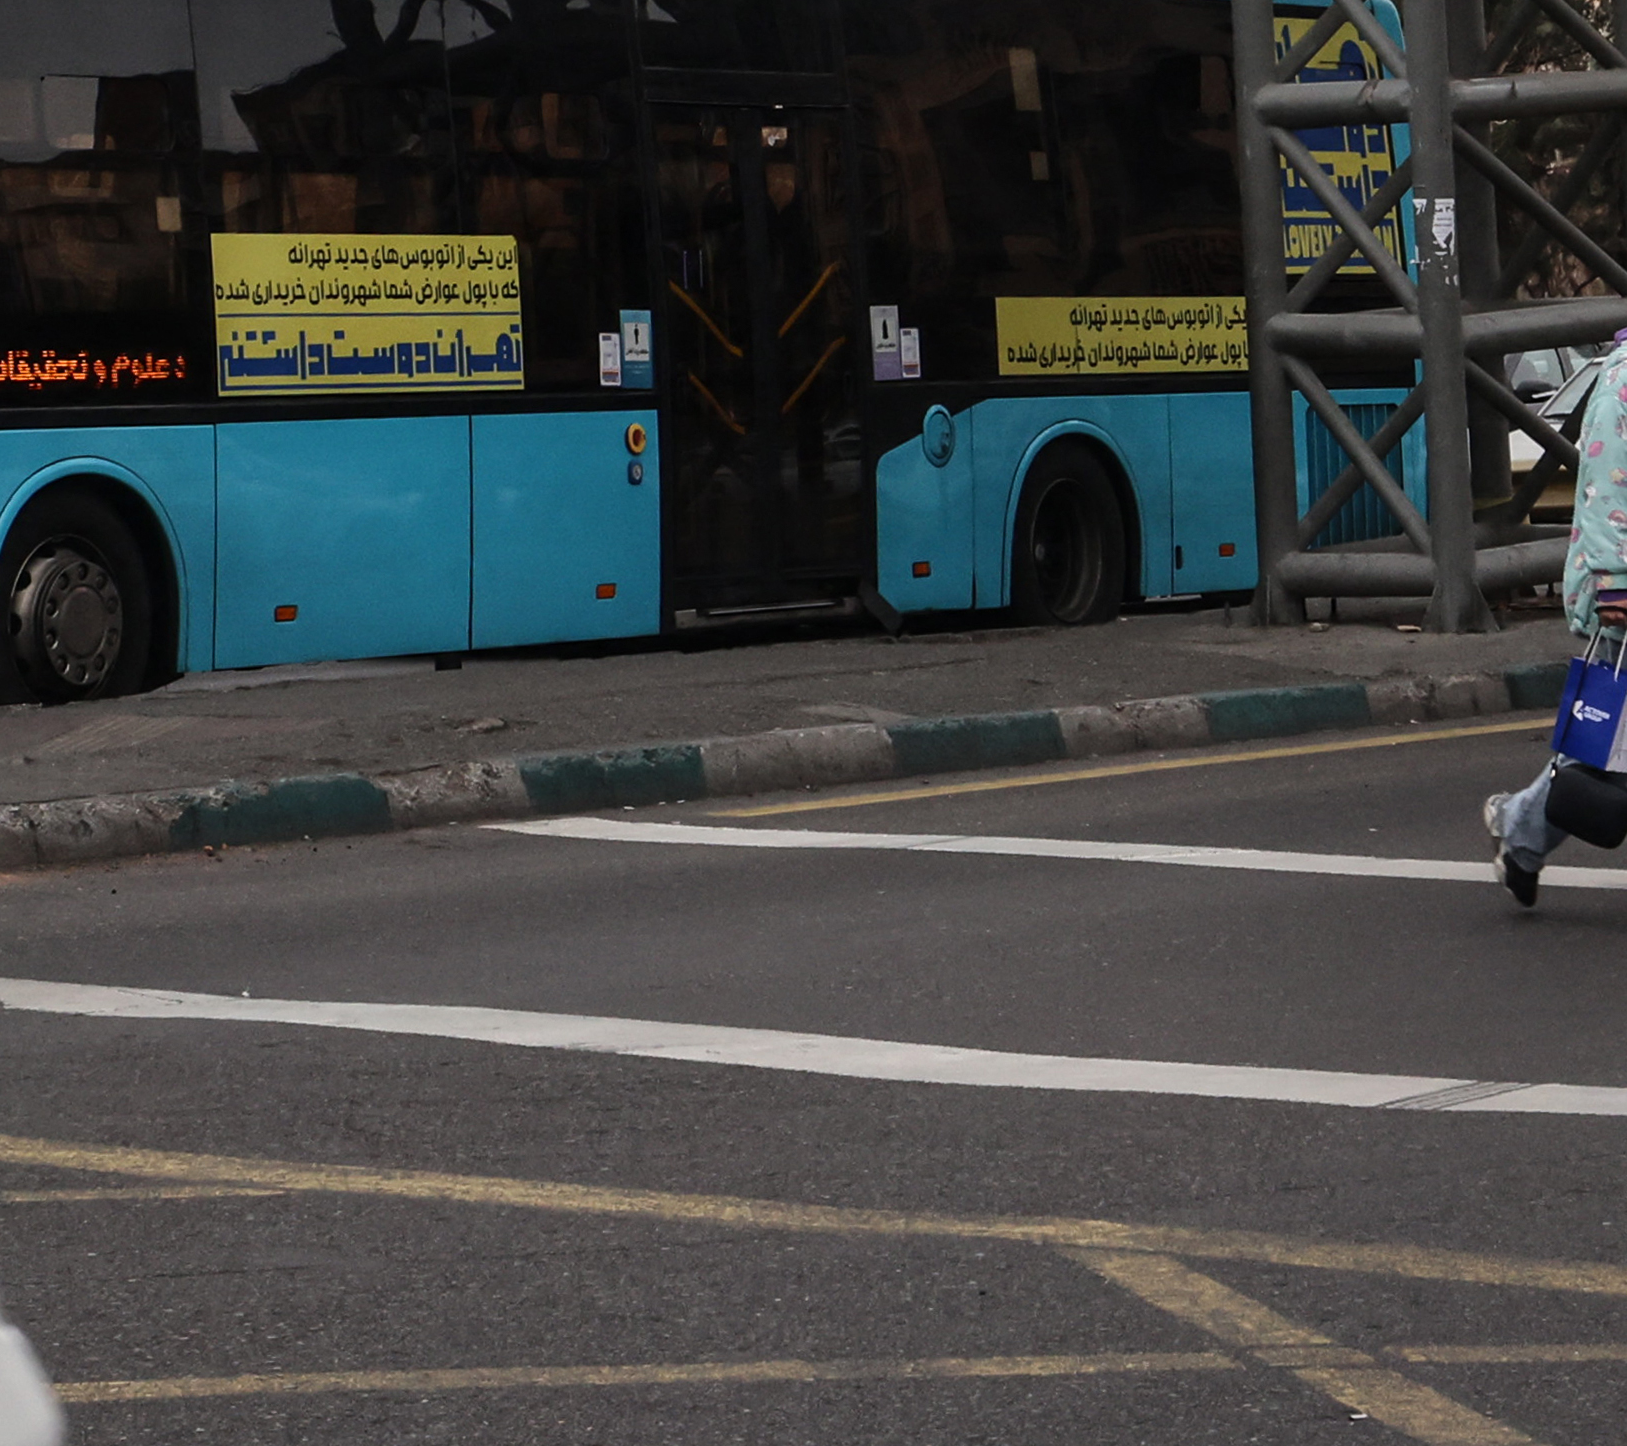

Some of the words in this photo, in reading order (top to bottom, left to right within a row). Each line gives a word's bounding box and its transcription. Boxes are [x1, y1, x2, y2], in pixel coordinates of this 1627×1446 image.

[288, 242, 331, 270] تهرانه
[335, 245, 368, 270] جدید
[456, 244, 466, 270] از
[467, 244, 494, 271] یکی
[497, 243, 519, 270] این
[215, 279, 250, 301] شده
[252, 277, 306, 306] خریداری
[309, 278, 382, 306] شهروندان
[383, 279, 413, 301] شما
[415, 278, 460, 306] عوارض
[462, 280, 489, 308] پول
[501, 279, 519, 301] که
[1069, 304, 1107, 332] تهرانه
[1110, 307, 1140, 331] جدید
[1007, 341, 1037, 364] شده
[1039, 339, 1085, 368] خریداری
[1088, 339, 1152, 367] شهروندان
[1153, 339, 1178, 361] شما
[1180, 338, 1218, 365] عوارض
[91, 358, 108, 388] و
[111, 352, 171, 388] علوم
